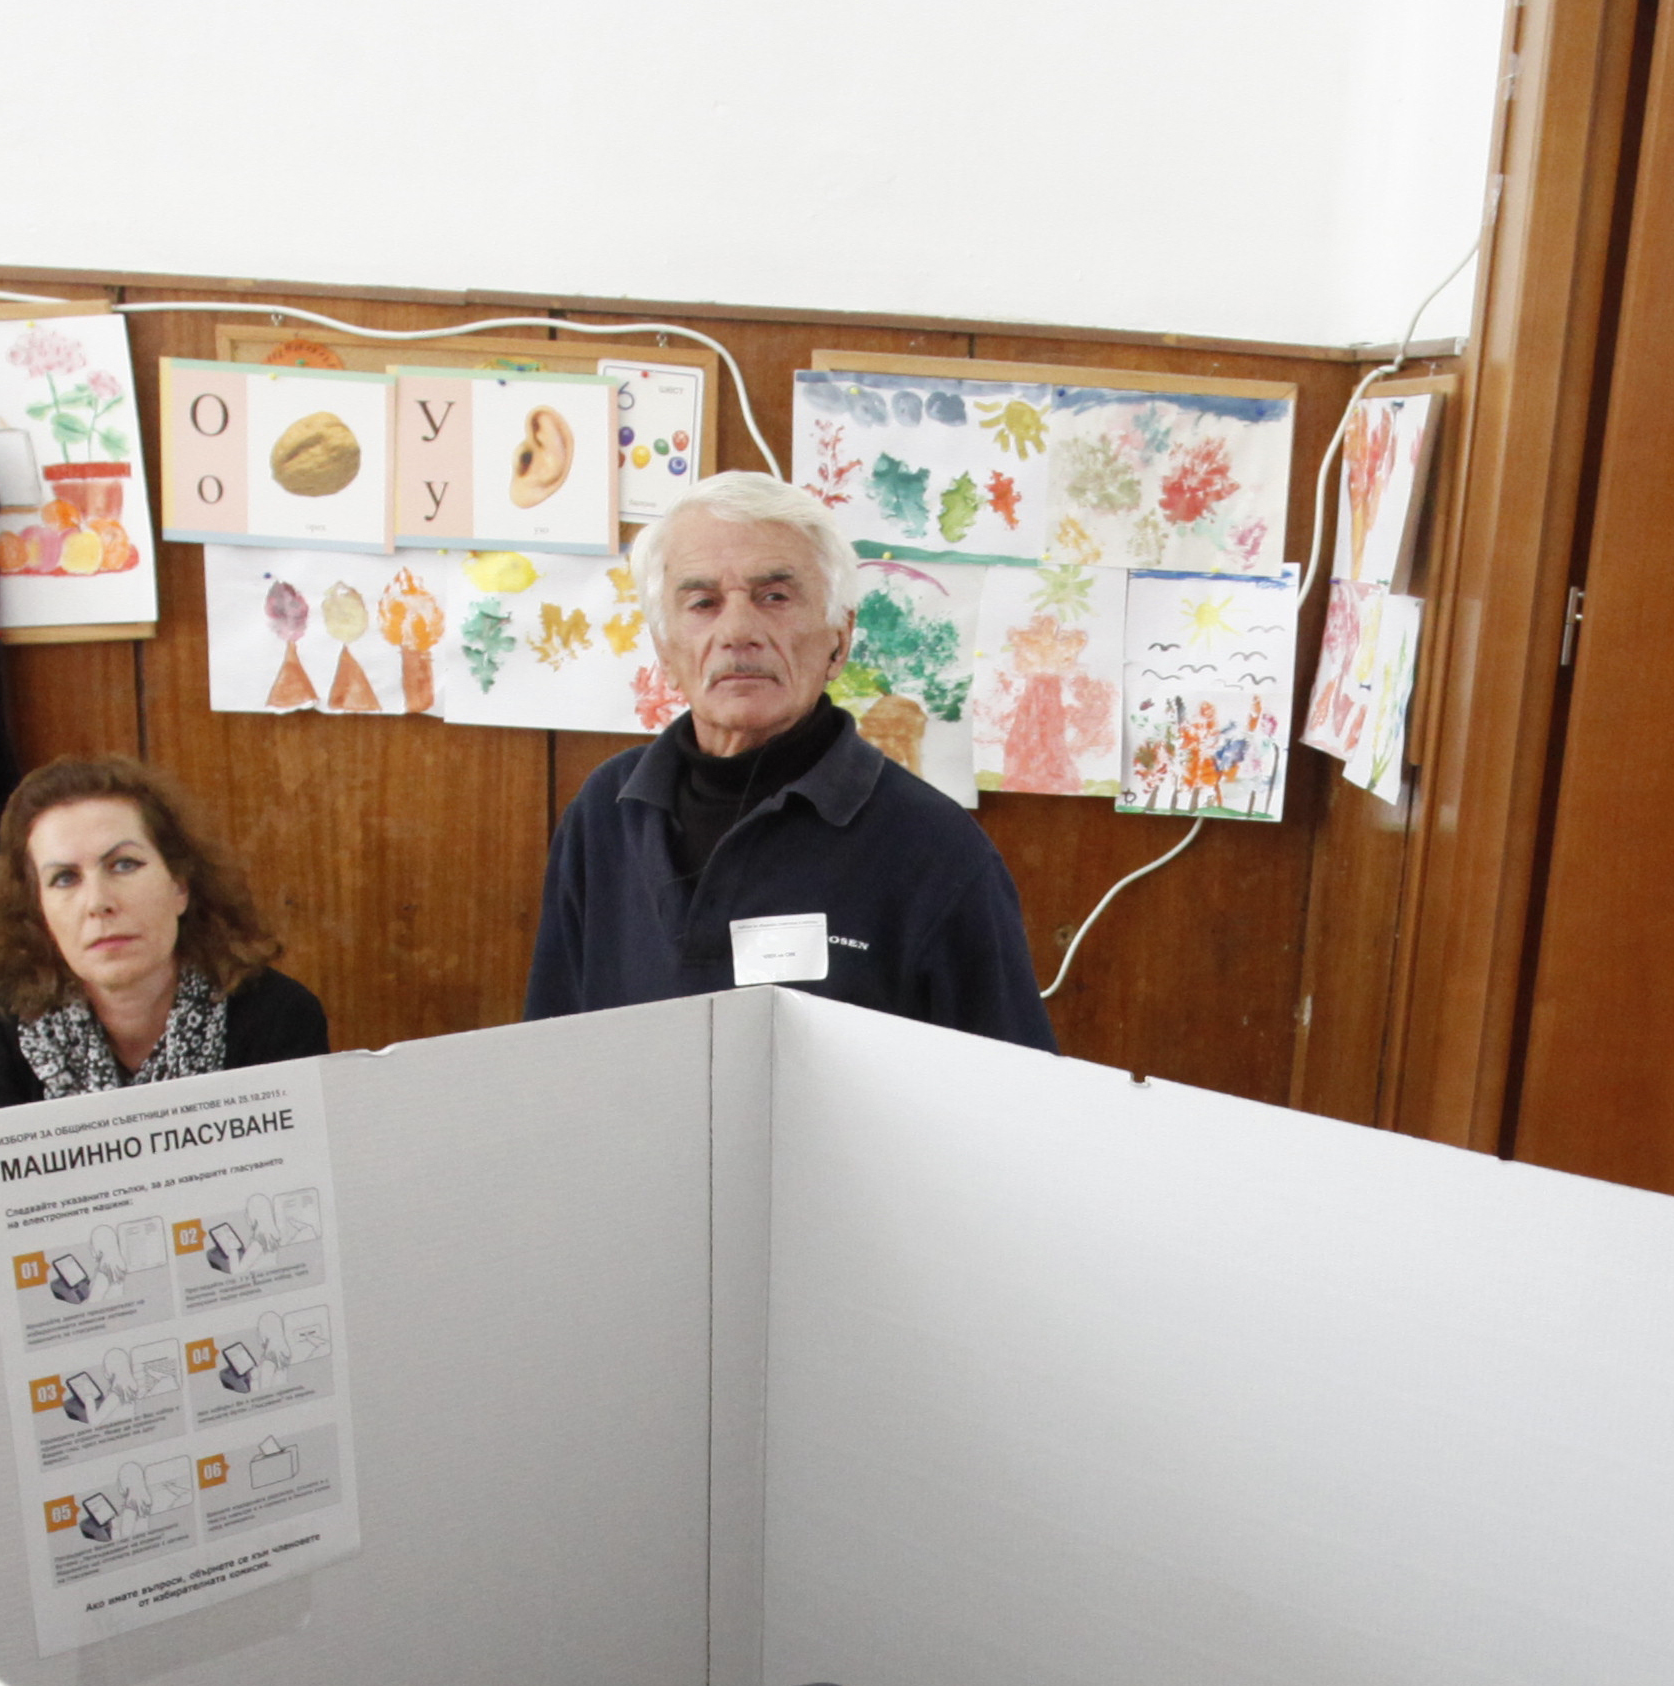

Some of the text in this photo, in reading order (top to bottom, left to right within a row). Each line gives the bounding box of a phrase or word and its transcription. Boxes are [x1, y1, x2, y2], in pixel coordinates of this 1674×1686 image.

[39, 1128, 53, 1139] ЗА
[55, 1118, 110, 1136] ОБЩИНСКИ
[112, 1109, 170, 1126] СЪВЕТНИЦИ
[180, 1100, 222, 1115] КМЕТОВЕ
[0, 1109, 295, 1182] МАШИННО ГЛАСУВАНЕ
[5, 1200, 57, 1218] Следвайте
[60, 1190, 110, 1208] указаните
[179, 1227, 198, 1245] 02
[20, 1261, 39, 1279] 01
[192, 1347, 211, 1364] 04
[37, 1384, 57, 1402] 03
[203, 1463, 222, 1480] 06
[52, 1505, 71, 1523] 05
[85, 1600, 105, 1613] Ако
[107, 1590, 138, 1607] имате
[237, 1555, 249, 1564] се
[138, 1599, 150, 1608] от
